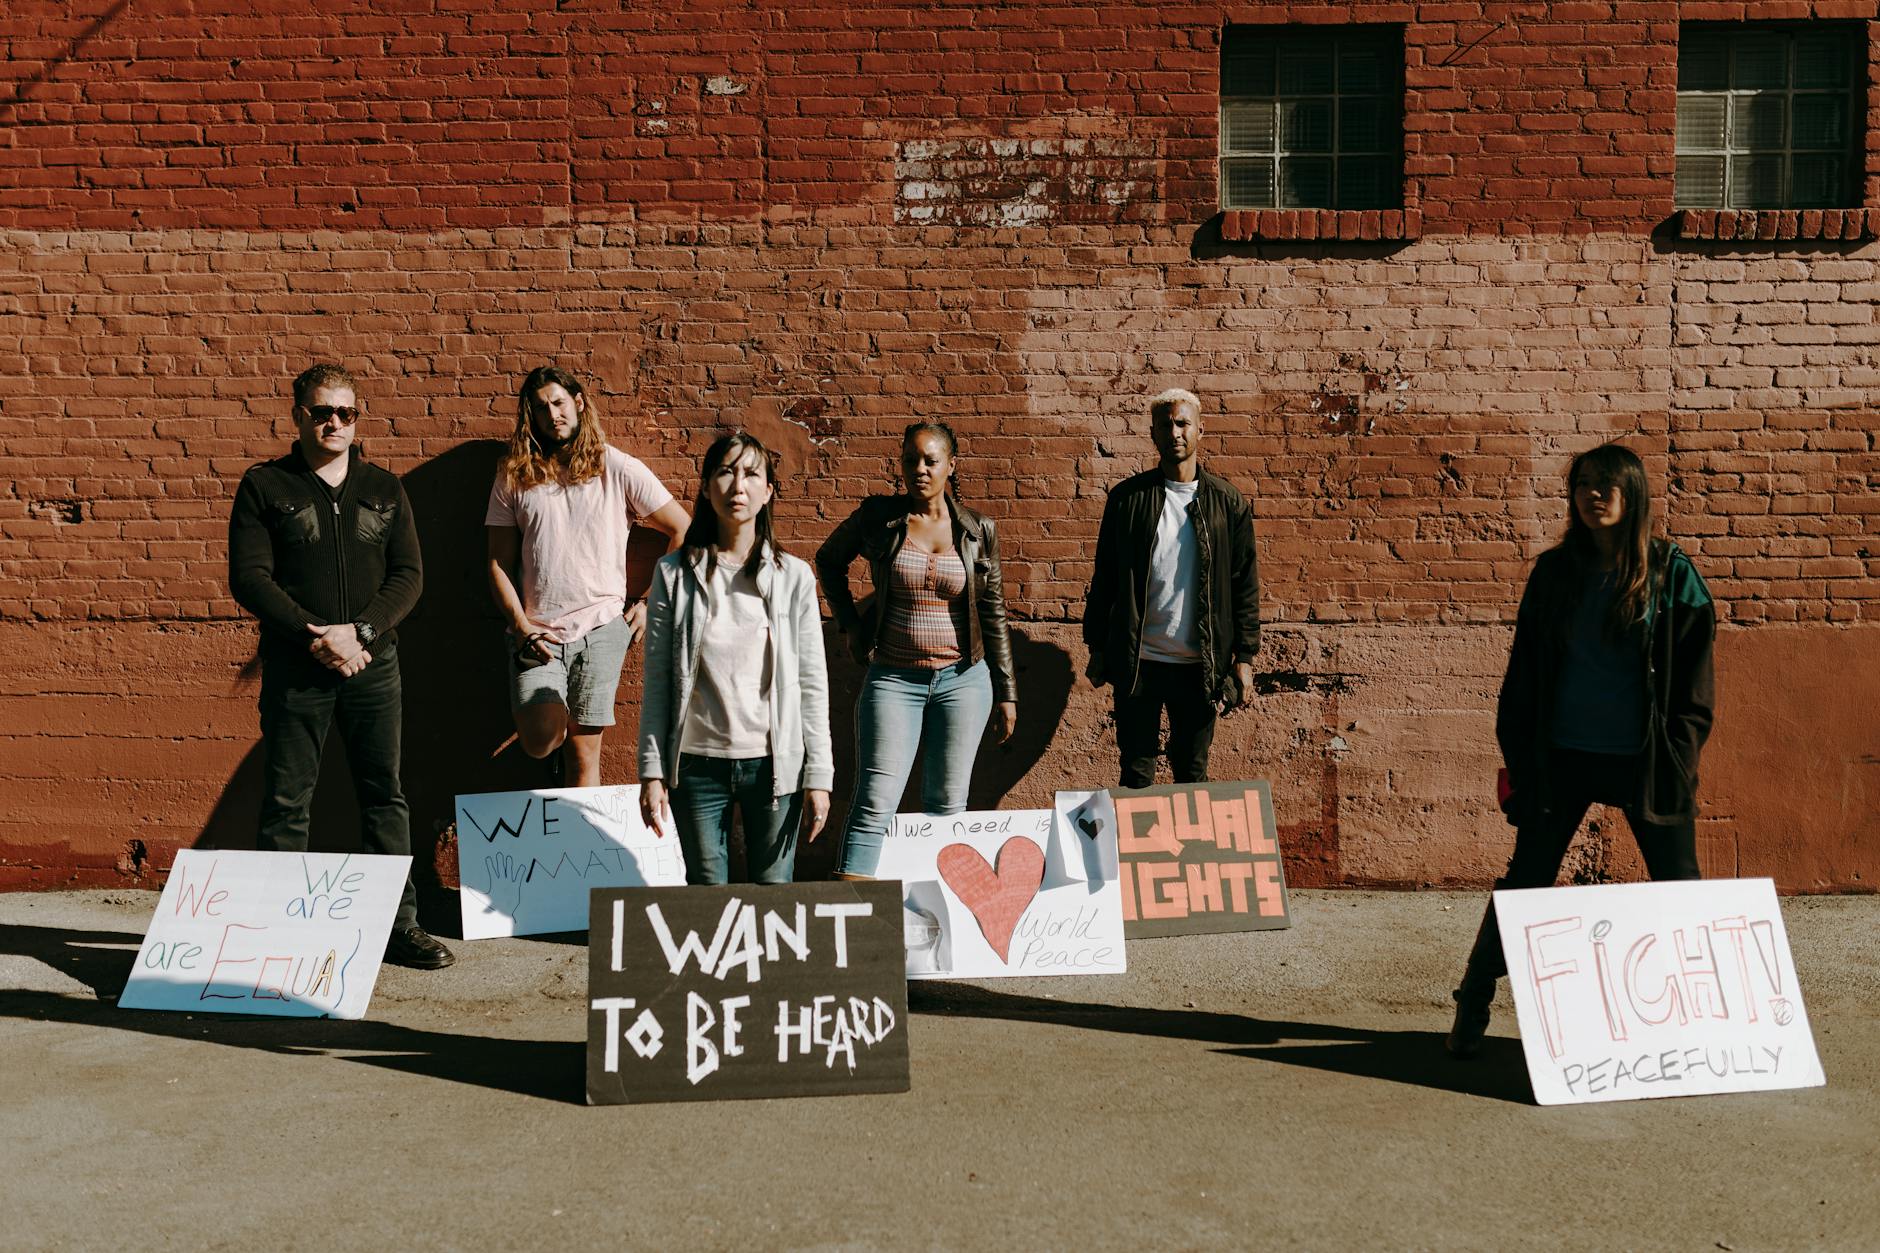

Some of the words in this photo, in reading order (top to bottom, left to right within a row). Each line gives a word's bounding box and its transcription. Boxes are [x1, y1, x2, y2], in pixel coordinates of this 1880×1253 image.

[462, 797, 561, 843] WE
[905, 822, 933, 838] we
[952, 815, 1012, 837] need
[1035, 816, 1053, 832] is
[1110, 789, 1276, 857] QUAL
[175, 859, 229, 918] We
[302, 853, 366, 895] We
[1118, 861, 1285, 922] IGHTS
[286, 894, 353, 920] are
[1015, 904, 1105, 939] World
[145, 941, 202, 973] are
[611, 899, 626, 972] I
[645, 897, 873, 983] WANT
[1019, 936, 1120, 969] Peace
[591, 996, 664, 1073] TO
[686, 990, 751, 1085] BE
[773, 995, 895, 1076] HEARD
[1563, 1045, 1784, 1096] PEACEFULLY
